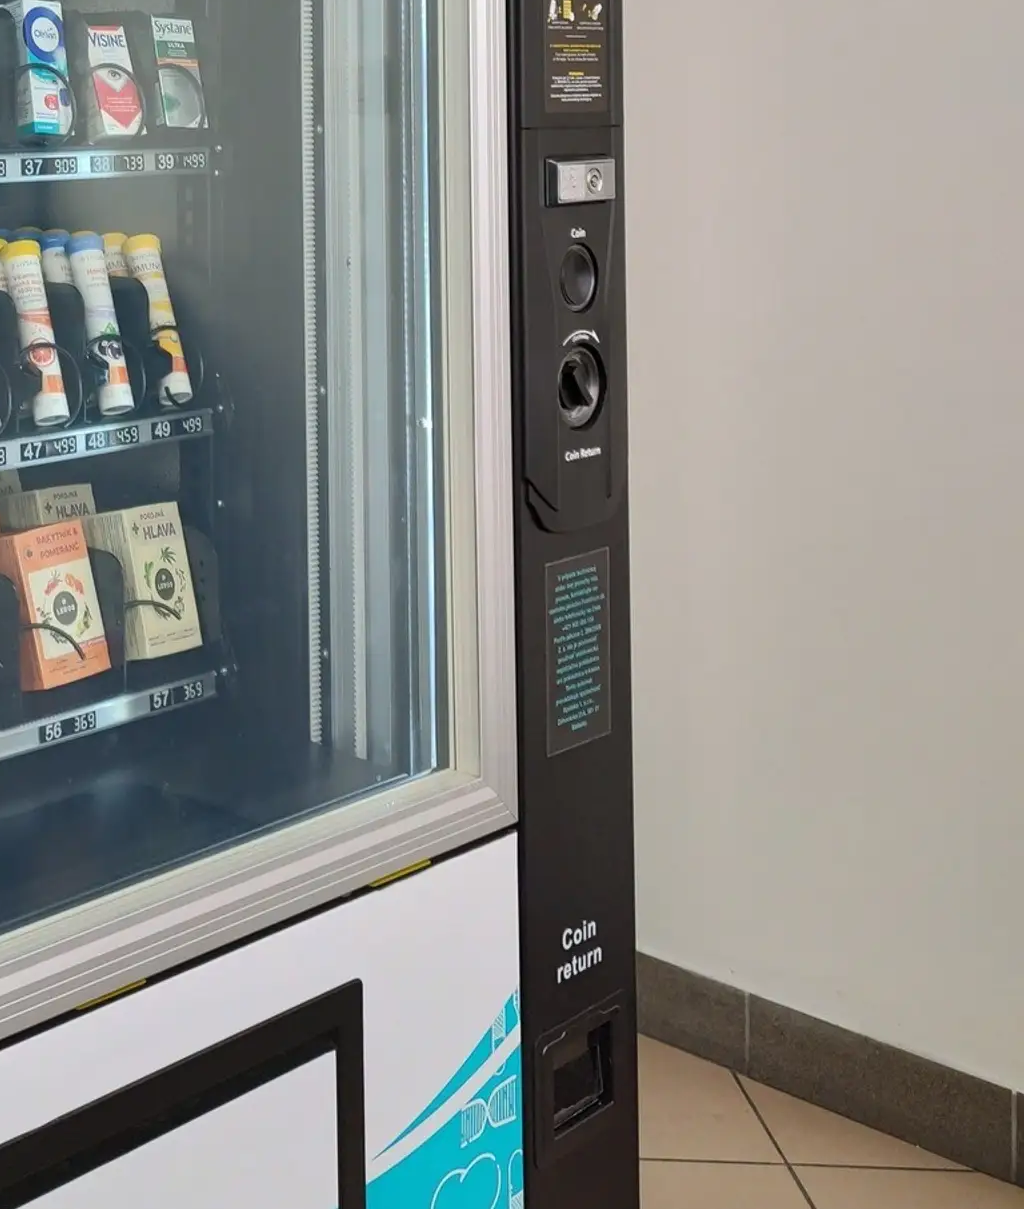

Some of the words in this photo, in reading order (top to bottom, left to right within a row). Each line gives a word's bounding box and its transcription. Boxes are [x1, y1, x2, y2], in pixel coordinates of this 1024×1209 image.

[154, 19, 193, 38] Systane
[87, 32, 126, 48] VISINE
[25, 159, 43, 175] 37
[54, 157, 76, 174] 909
[93, 157, 110, 172] 38
[157, 154, 175, 170] 39
[183, 153, 206, 169] 1499
[570, 228, 587, 239] Coin
[154, 422, 171, 438] 49
[182, 416, 204, 433] 499
[88, 431, 106, 447] 48
[117, 426, 139, 443] 459
[23, 443, 42, 461] 47
[53, 437, 76, 454] 499
[565, 450, 580, 462] Coin
[580, 447, 601, 460] Return
[55, 503, 90, 518] HLAVA
[143, 525, 176, 540] HLAVA
[153, 691, 169, 709] 57
[183, 681, 203, 701] 369
[45, 721, 62, 741] 56
[74, 714, 96, 733] 369
[562, 919, 597, 950] Coin
[557, 946, 602, 984] return
